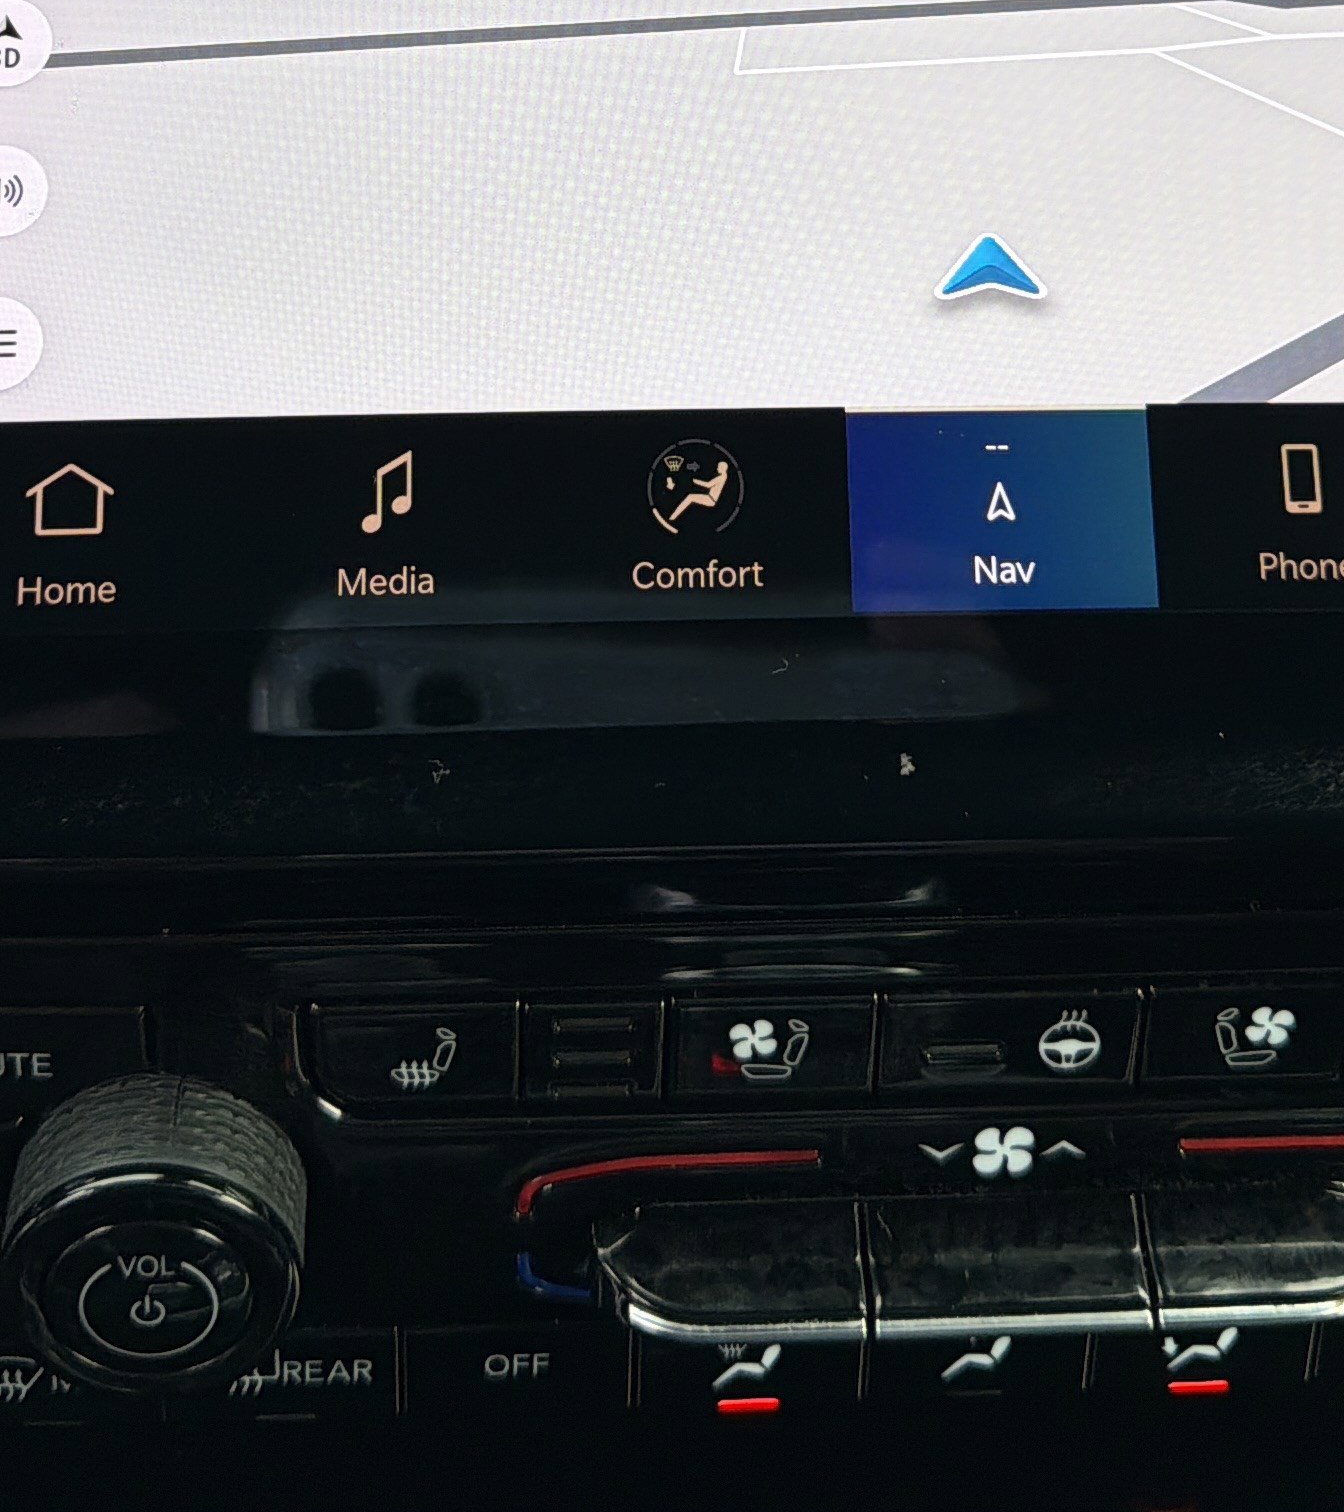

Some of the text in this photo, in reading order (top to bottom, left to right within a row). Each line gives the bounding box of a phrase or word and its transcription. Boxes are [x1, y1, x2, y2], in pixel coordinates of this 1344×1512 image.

[337, 567, 435, 596] Media
[632, 559, 764, 590] Comfort
[973, 553, 1037, 584] Nav
[16, 575, 117, 607] Home
[116, 1254, 176, 1279] VOL
[282, 1359, 373, 1384] REAR
[483, 1353, 550, 1378] OFF
